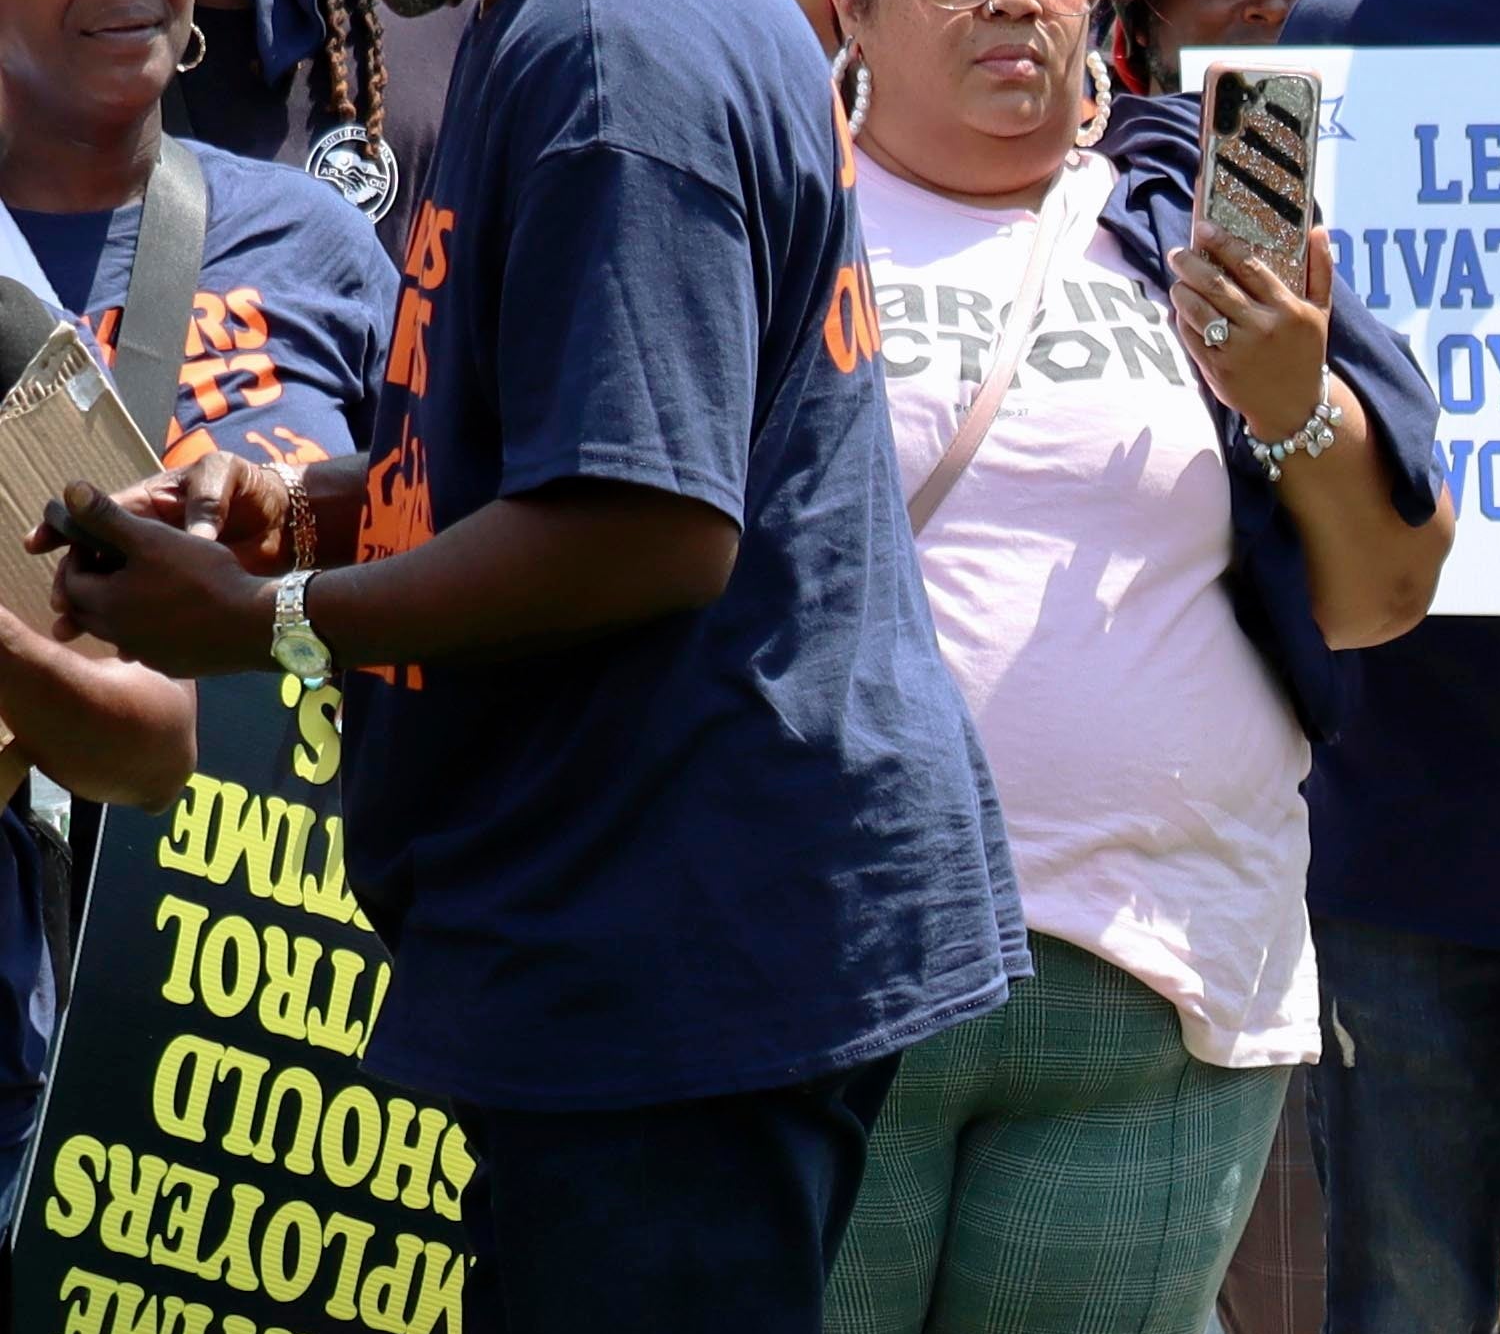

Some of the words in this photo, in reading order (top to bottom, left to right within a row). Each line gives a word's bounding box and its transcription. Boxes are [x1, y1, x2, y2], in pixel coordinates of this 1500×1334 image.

[157, 773, 376, 933] TIME
[155, 894, 392, 1061] TROL
[151, 1033, 478, 1223] SHOULD
